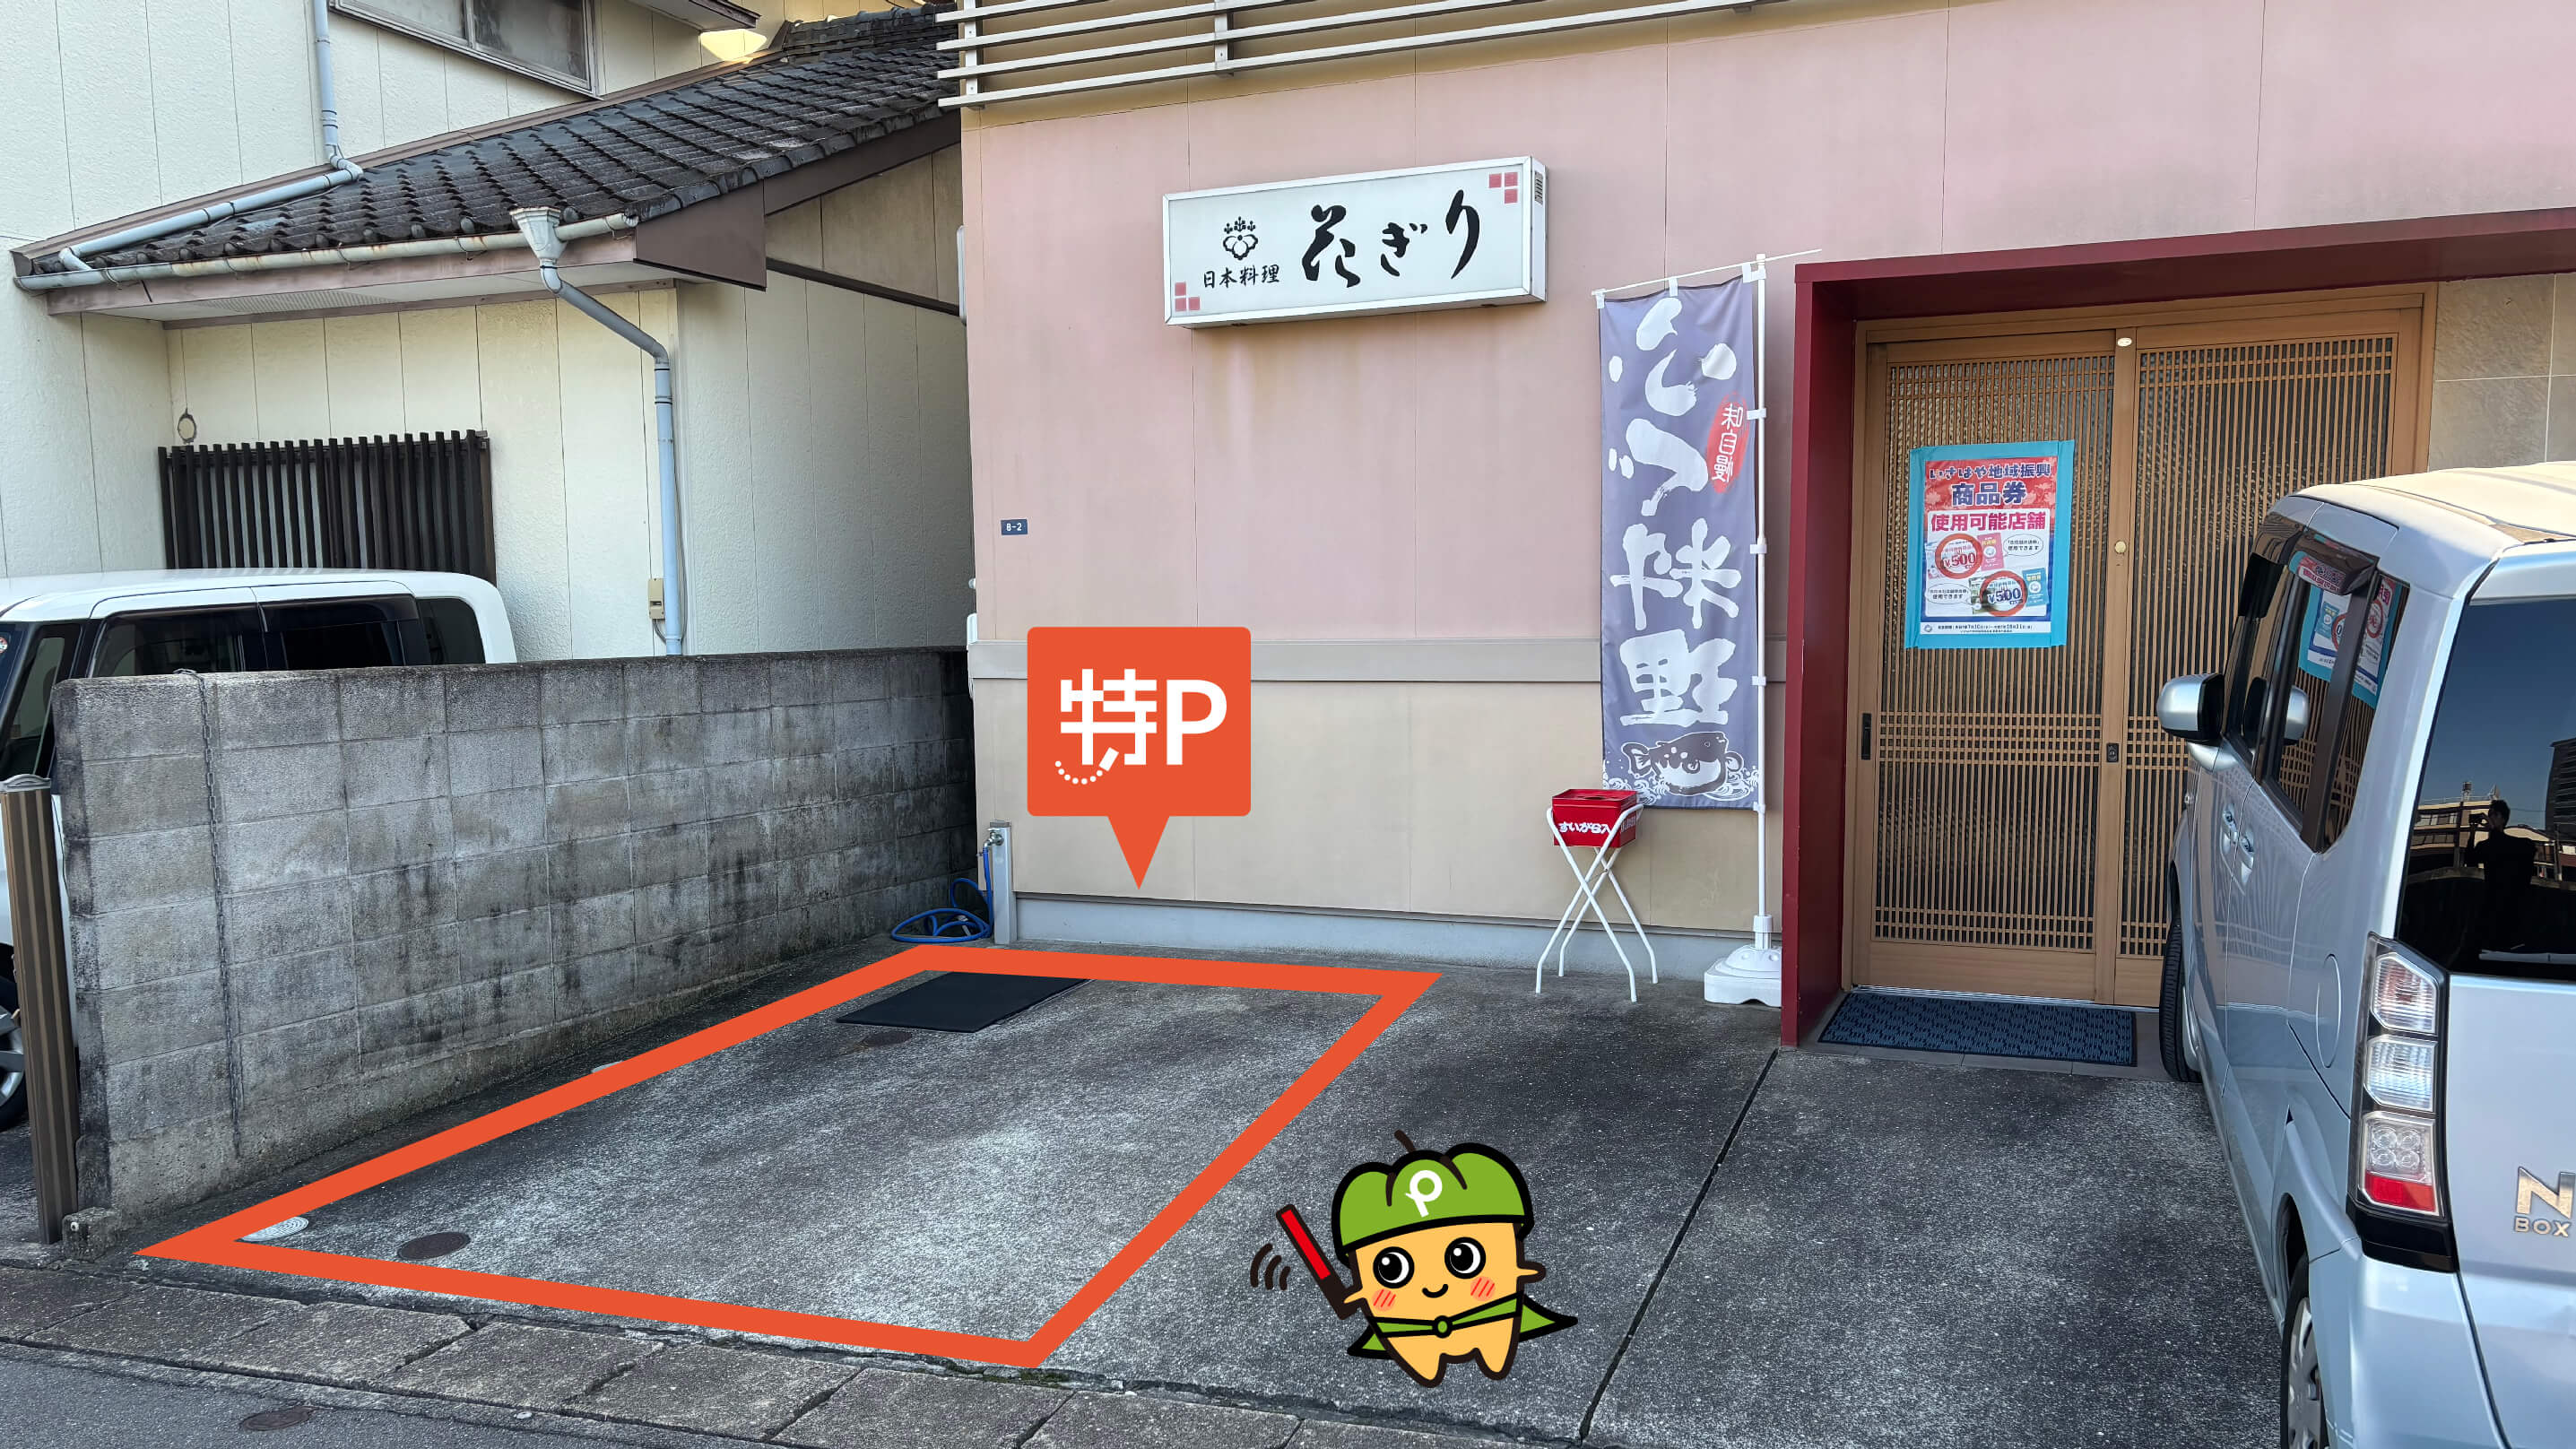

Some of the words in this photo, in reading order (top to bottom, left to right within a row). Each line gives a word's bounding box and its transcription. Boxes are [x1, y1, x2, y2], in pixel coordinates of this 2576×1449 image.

[1301, 188, 1480, 288] 花ぎり
[1203, 264, 1280, 289] 日本料理
[1929, 462, 2051, 480] いさはや地域振興
[1952, 480, 2027, 507] 商品券
[1930, 511, 2047, 532] 使用可能店舗
[2516, 1166, 2576, 1220] N
[2514, 1216, 2572, 1238] BOX
